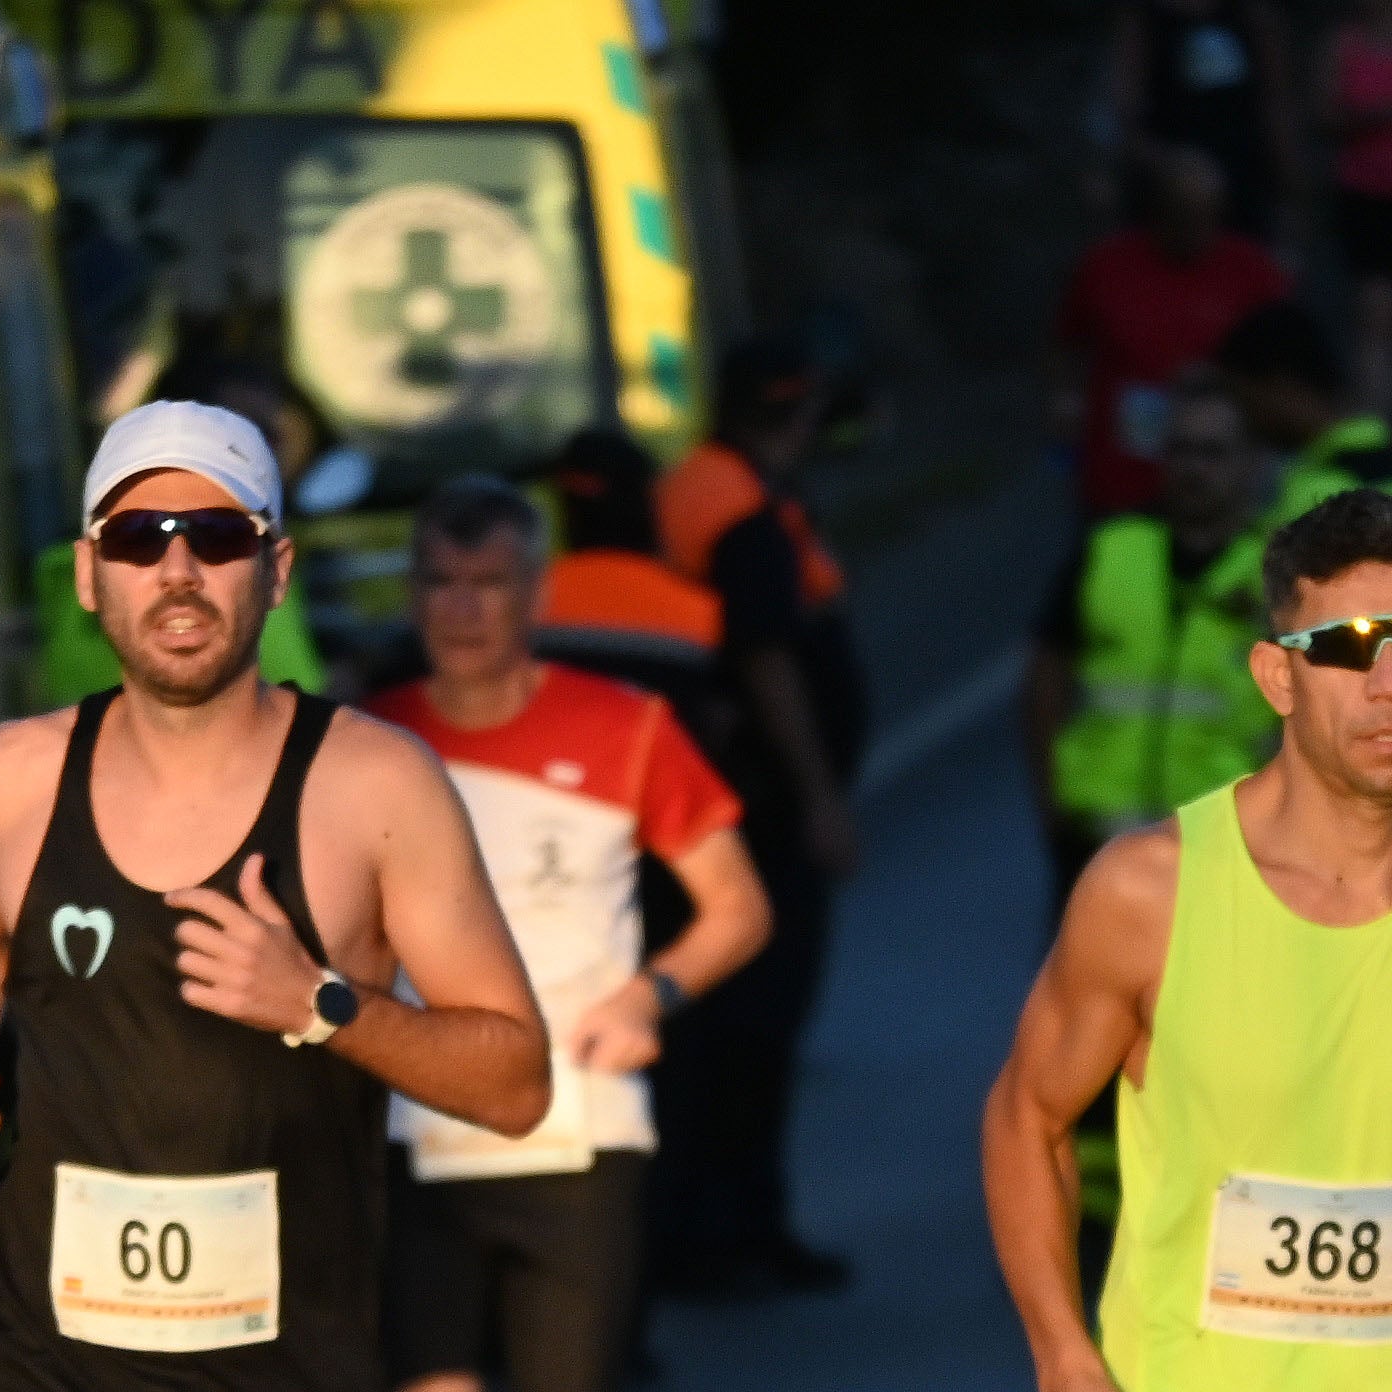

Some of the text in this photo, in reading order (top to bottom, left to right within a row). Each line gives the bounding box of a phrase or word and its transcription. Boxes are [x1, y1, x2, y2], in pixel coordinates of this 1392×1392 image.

[65, 0, 381, 98] DYA
[119, 1219, 193, 1284] 60
[1264, 1214, 1382, 1283] 368
